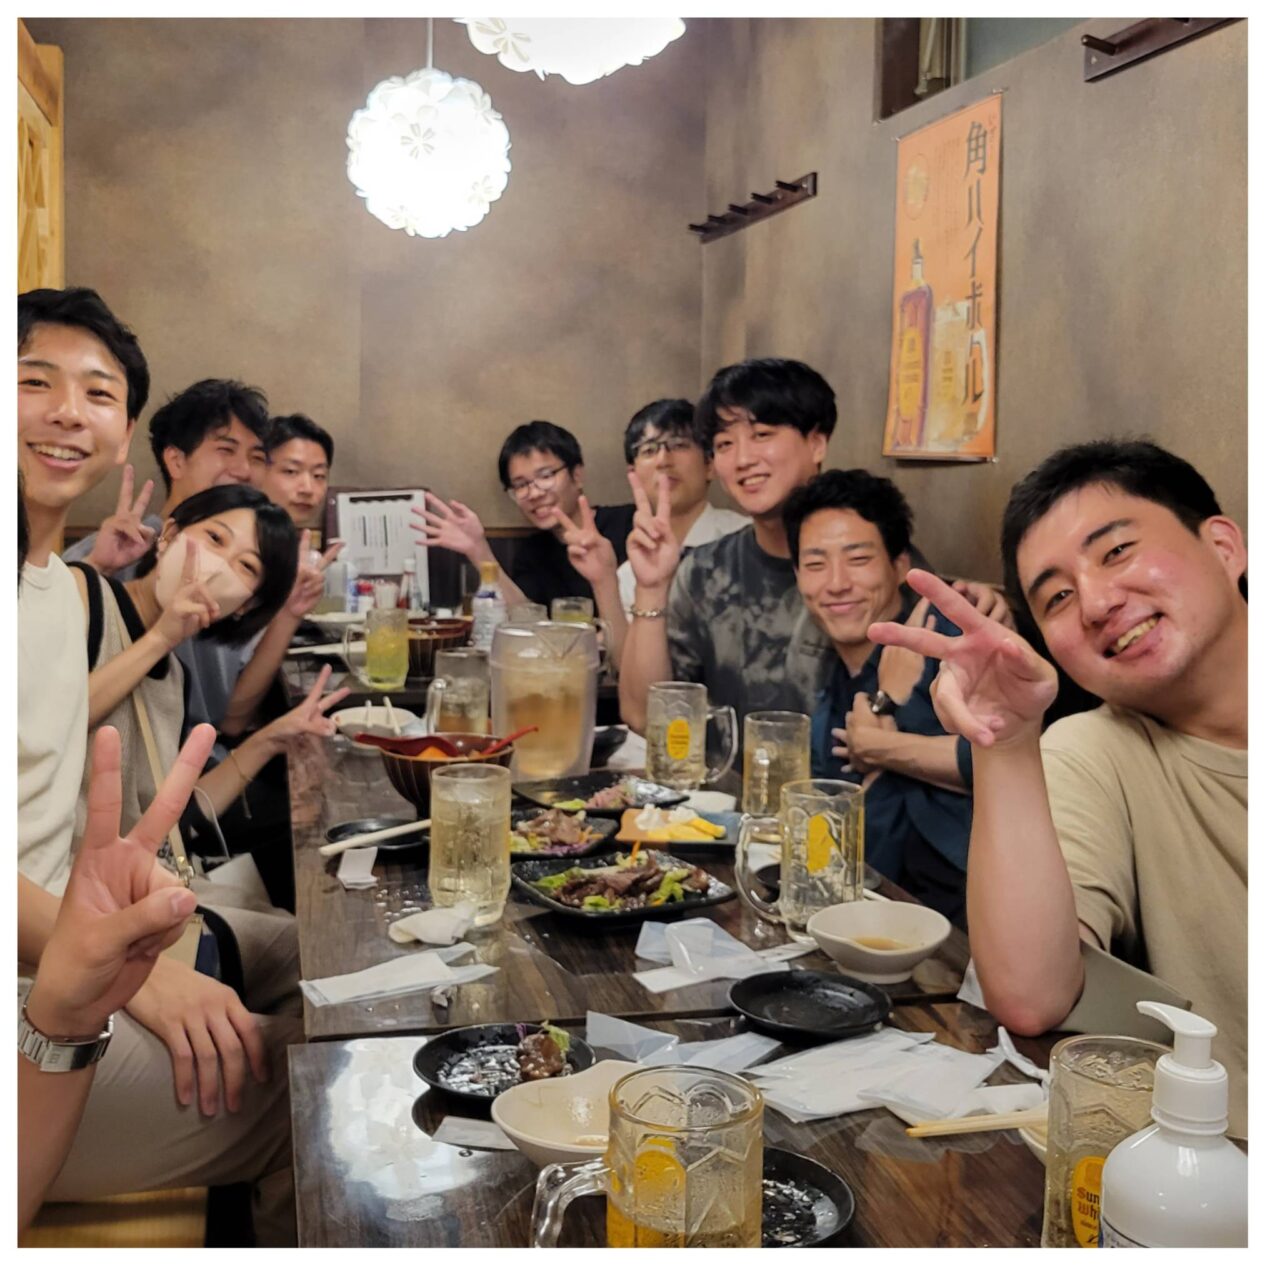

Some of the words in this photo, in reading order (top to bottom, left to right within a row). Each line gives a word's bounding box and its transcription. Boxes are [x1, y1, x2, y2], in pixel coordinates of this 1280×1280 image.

[961, 120, 987, 406] 角ハイボール
